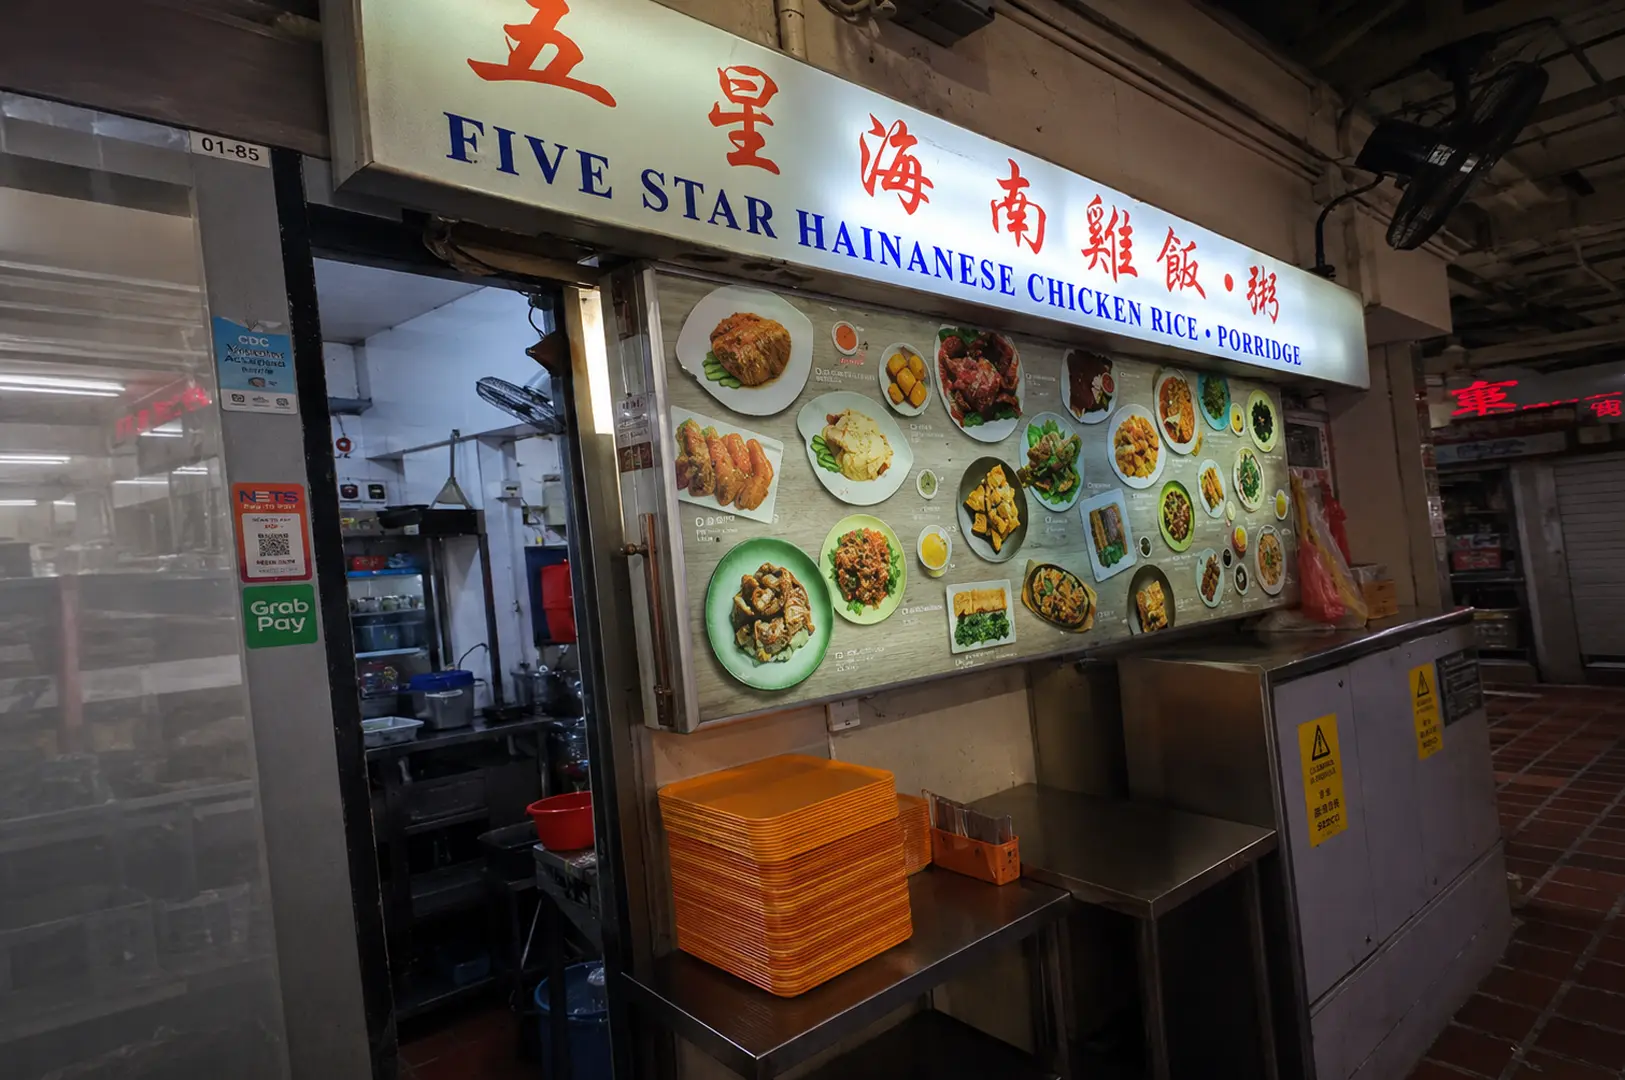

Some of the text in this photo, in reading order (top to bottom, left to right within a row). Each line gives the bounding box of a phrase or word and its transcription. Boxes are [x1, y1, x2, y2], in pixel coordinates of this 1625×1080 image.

[202, 137, 260, 161] 01-85
[443, 112, 1303, 367] FIVE STAR HAINANESE CHICKEN RICE PORRIDGE
[238, 334, 270, 348] CDC
[239, 490, 299, 503] NETS
[251, 598, 309, 616] Grab
[257, 616, 306, 634] Pay
